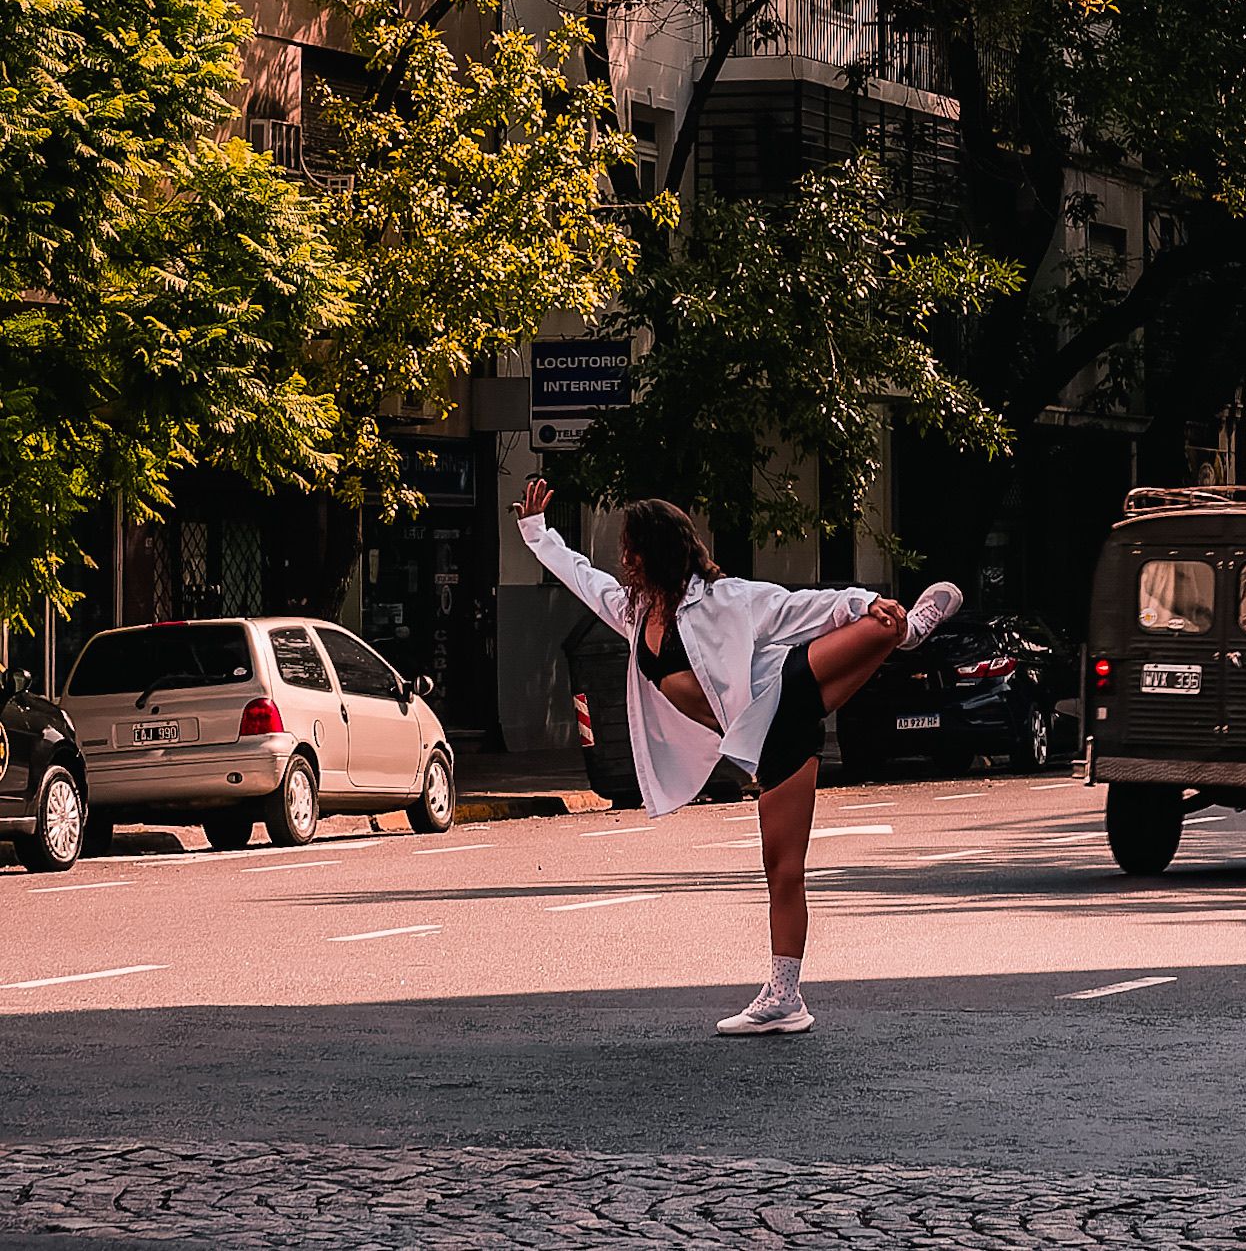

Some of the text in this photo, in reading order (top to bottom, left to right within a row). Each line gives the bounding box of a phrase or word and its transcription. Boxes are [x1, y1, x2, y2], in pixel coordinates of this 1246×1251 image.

[536, 356, 628, 369] LOCUTORIO
[543, 379, 622, 392] INTERNET
[557, 429, 582, 438] TELE
[898, 719, 909, 728] AD
[911, 718, 925, 727] 927
[134, 727, 177, 741] EAJ 990
